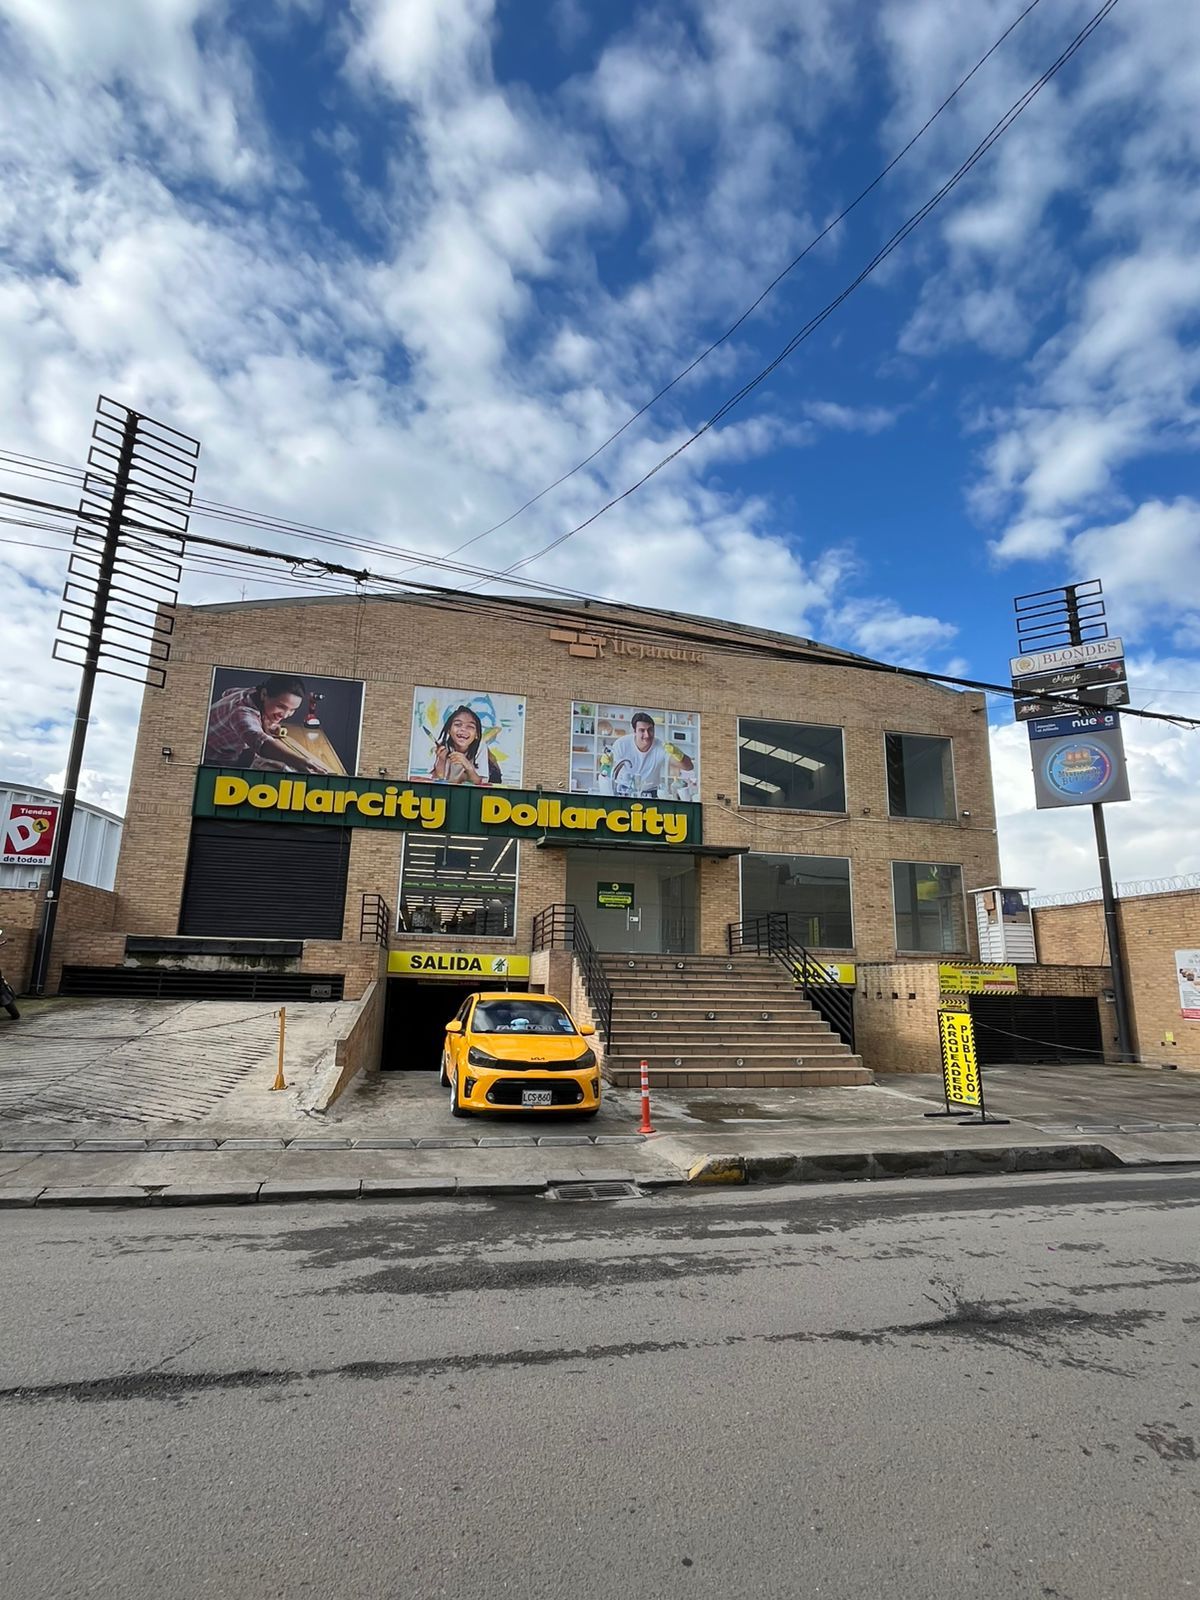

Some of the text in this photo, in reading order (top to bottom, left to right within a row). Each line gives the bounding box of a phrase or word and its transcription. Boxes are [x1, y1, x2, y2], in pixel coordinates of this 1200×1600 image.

[1043, 641, 1117, 665] BLONDES
[20, 807, 53, 816] Tiendas
[213, 775, 688, 844] Dollarcity Dollarcity
[3, 855, 47, 864] de todos!
[410, 955, 482, 971] SALIDA
[946, 1015, 964, 1100] PARQUEADERO
[960, 1025, 976, 1093] PUBLICO
